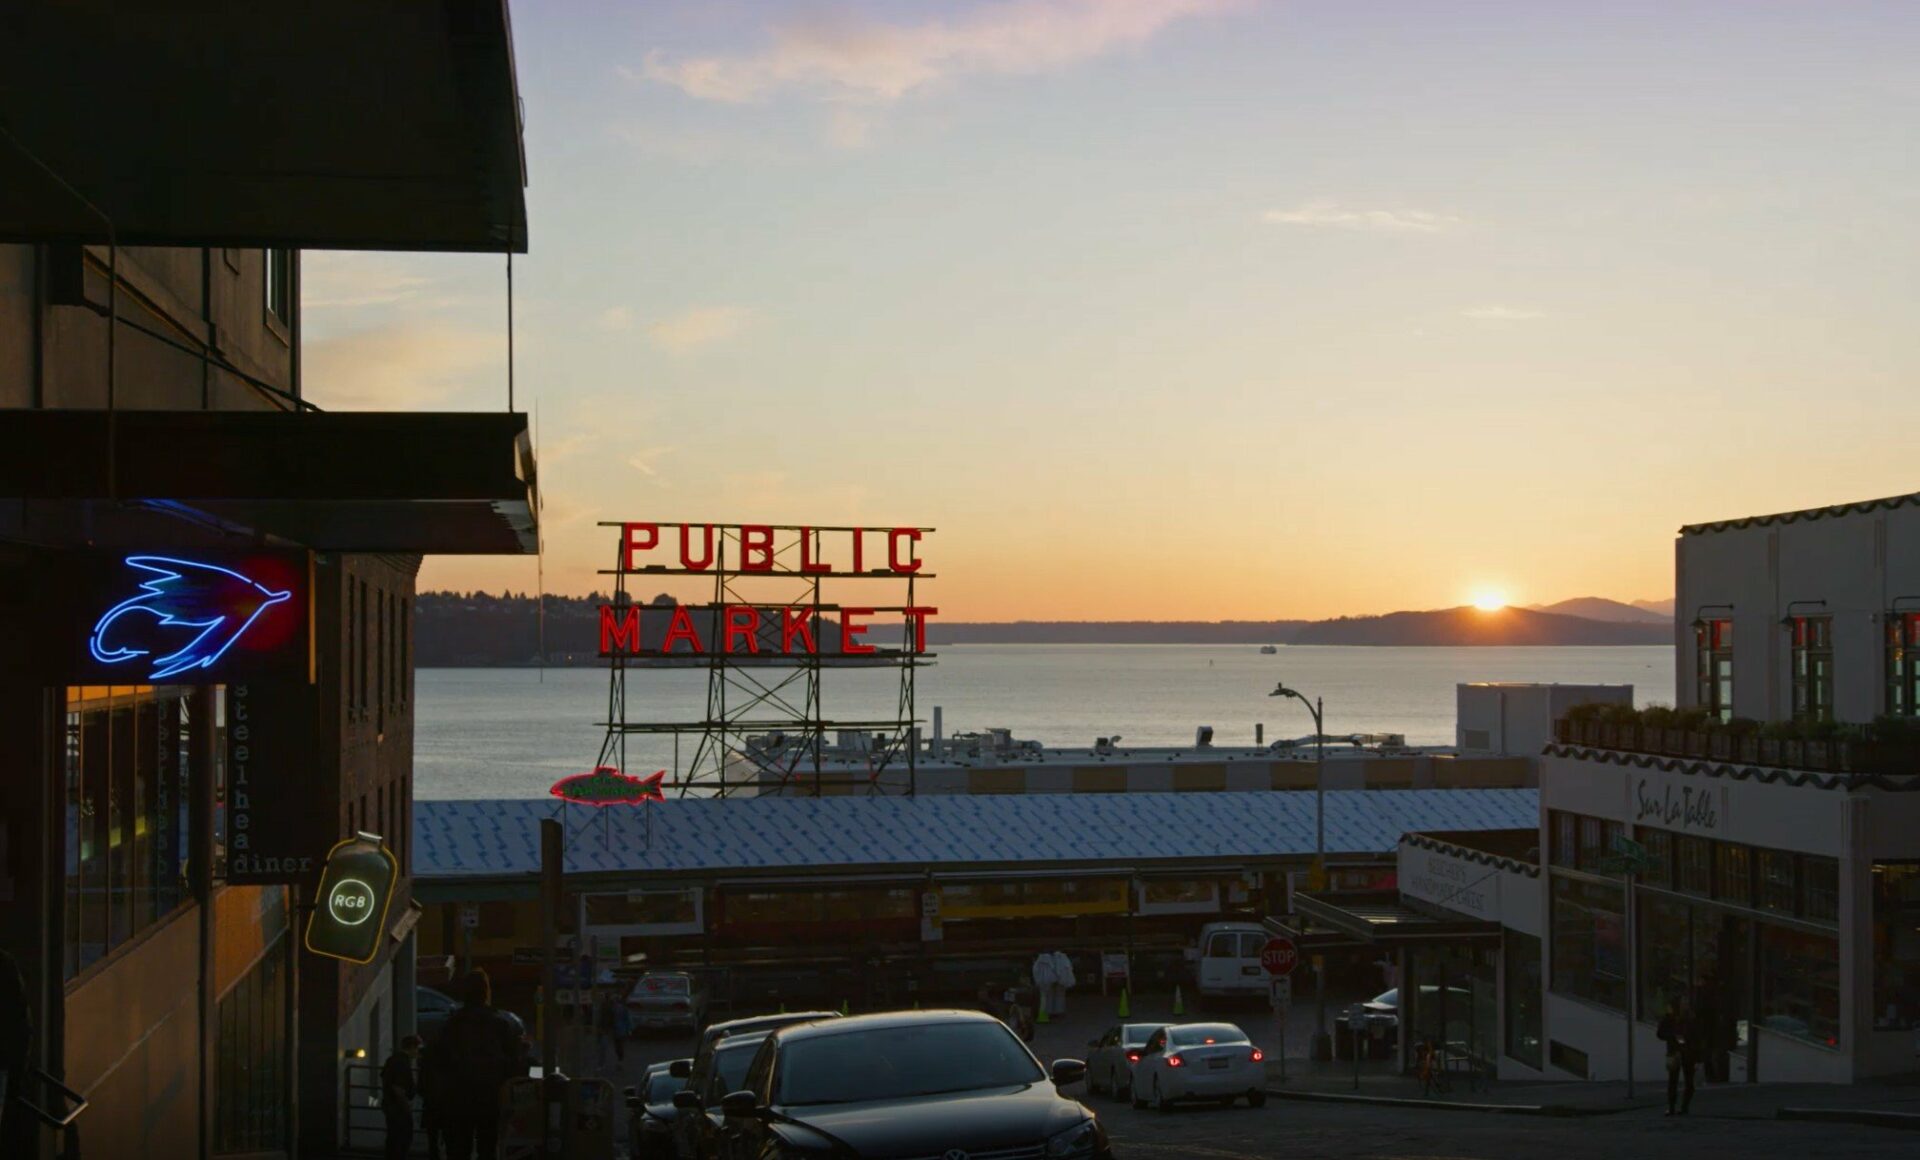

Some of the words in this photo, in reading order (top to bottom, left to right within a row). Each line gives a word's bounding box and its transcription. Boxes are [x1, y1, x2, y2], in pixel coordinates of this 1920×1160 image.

[622, 522, 922, 574] PUBLIC
[599, 604, 938, 655] MARKET
[1637, 779, 1661, 820] Sur
[1664, 784, 1681, 825] La
[1683, 786, 1718, 828] Table
[233, 853, 312, 874] diner
[334, 894, 366, 908] RGB
[1263, 949, 1295, 965] STOP
